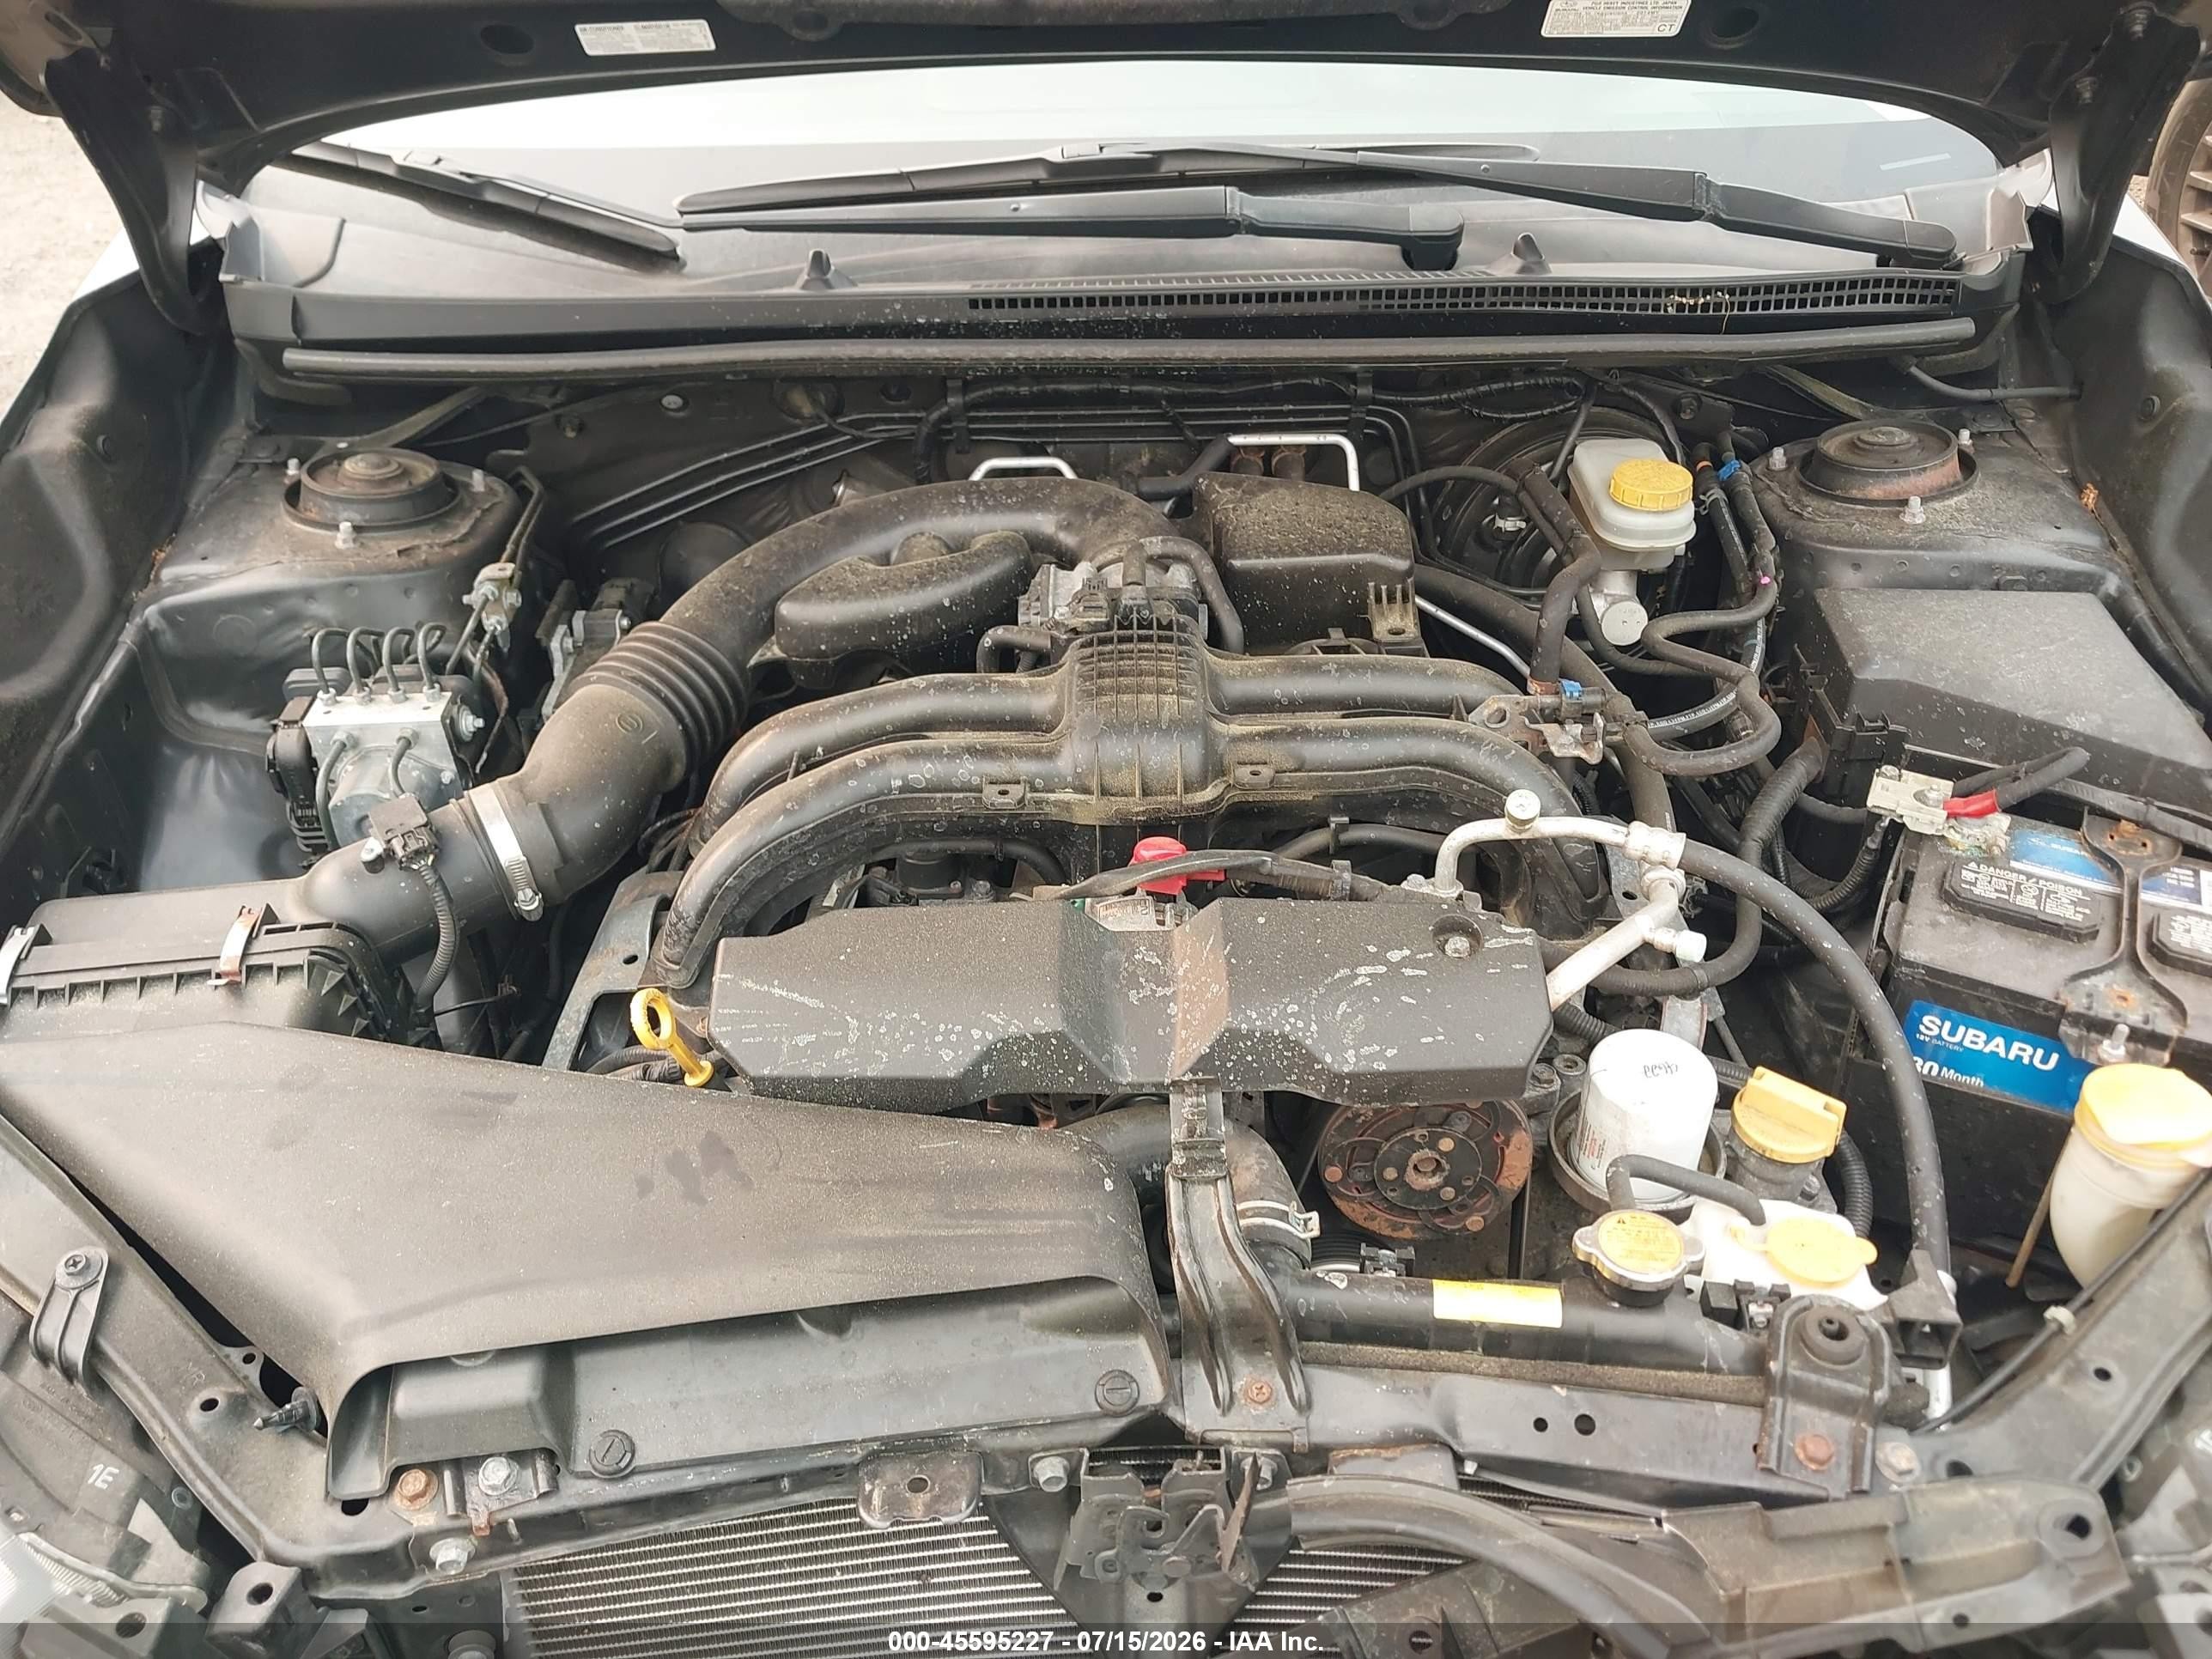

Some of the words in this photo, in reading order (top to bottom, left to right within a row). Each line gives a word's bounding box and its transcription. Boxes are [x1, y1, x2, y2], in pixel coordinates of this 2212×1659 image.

[1657, 23, 1675, 33] CT
[1979, 864, 2027, 882] DANGER
[2039, 879, 2083, 896] POISON
[1918, 1015, 2060, 1071] SUBARU
[1931, 1038, 1965, 1053] BATTERY
[1941, 1066, 1984, 1088] Month
[88, 1463, 119, 1490] 1E
